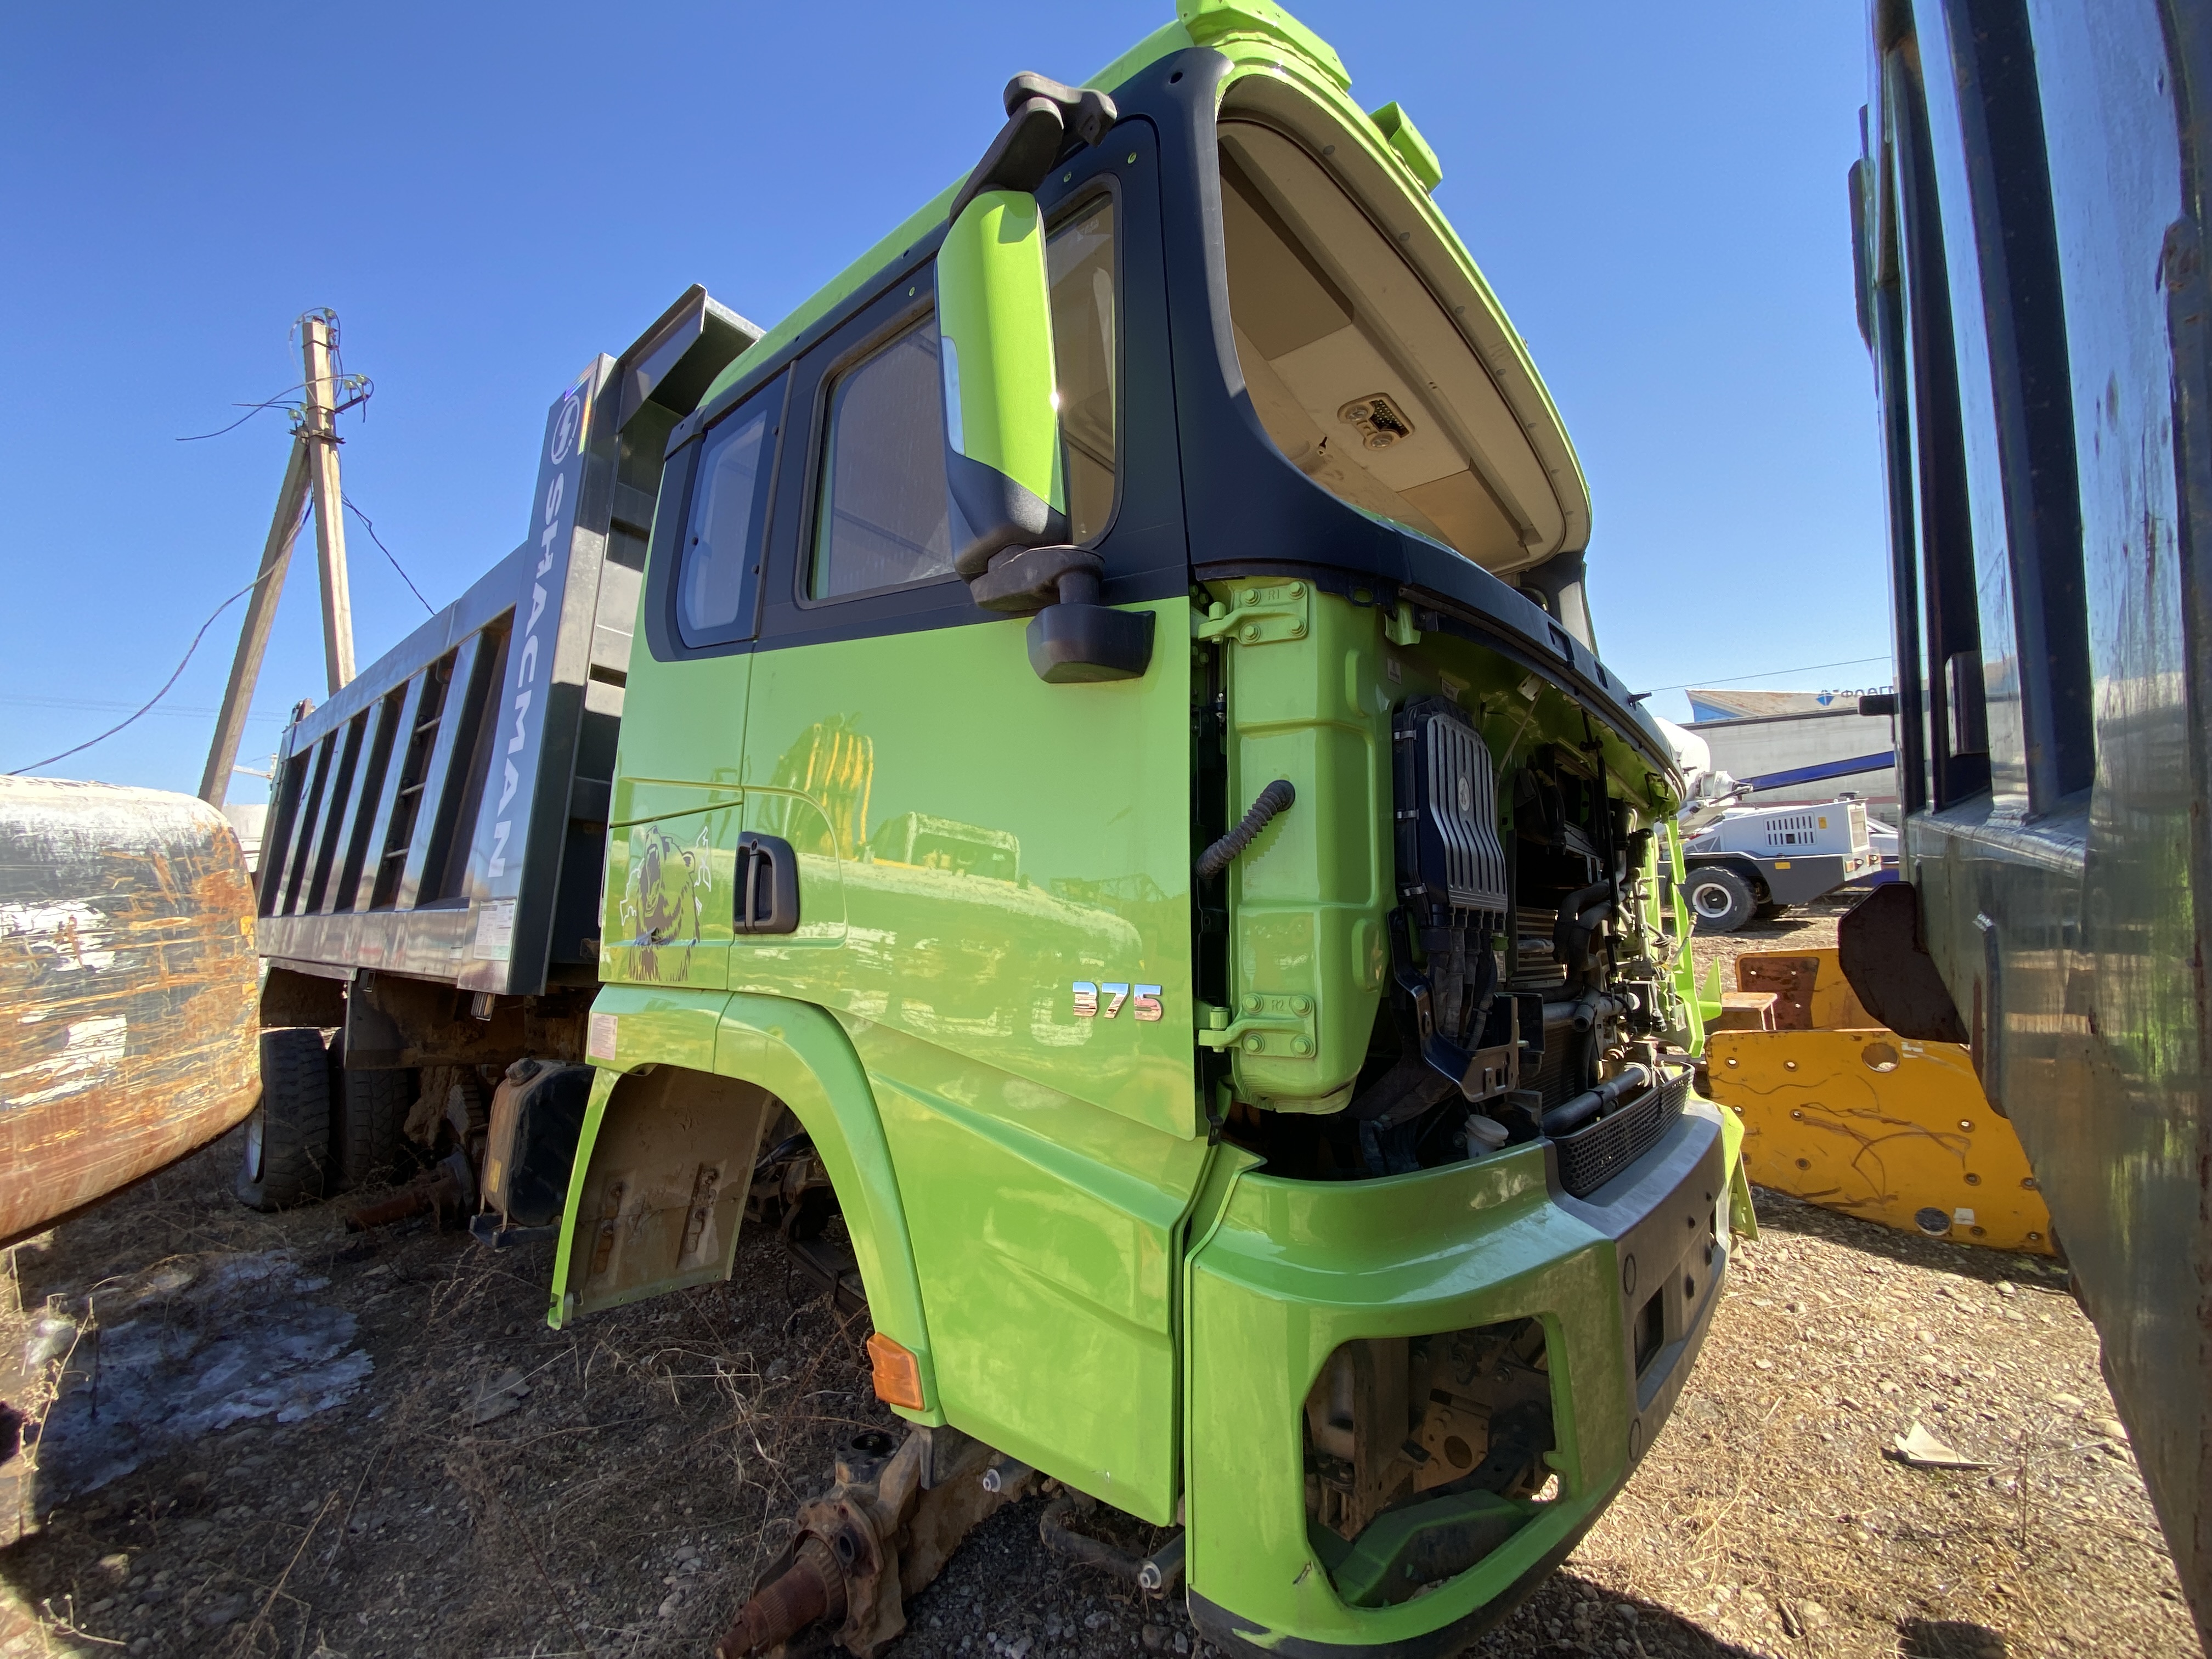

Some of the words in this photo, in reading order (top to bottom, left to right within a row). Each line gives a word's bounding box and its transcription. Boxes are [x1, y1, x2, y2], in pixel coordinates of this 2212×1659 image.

[487, 473, 565, 878] SHACMAN
[1072, 980, 1163, 1022] 375
[1271, 1000, 1284, 1011] R2
